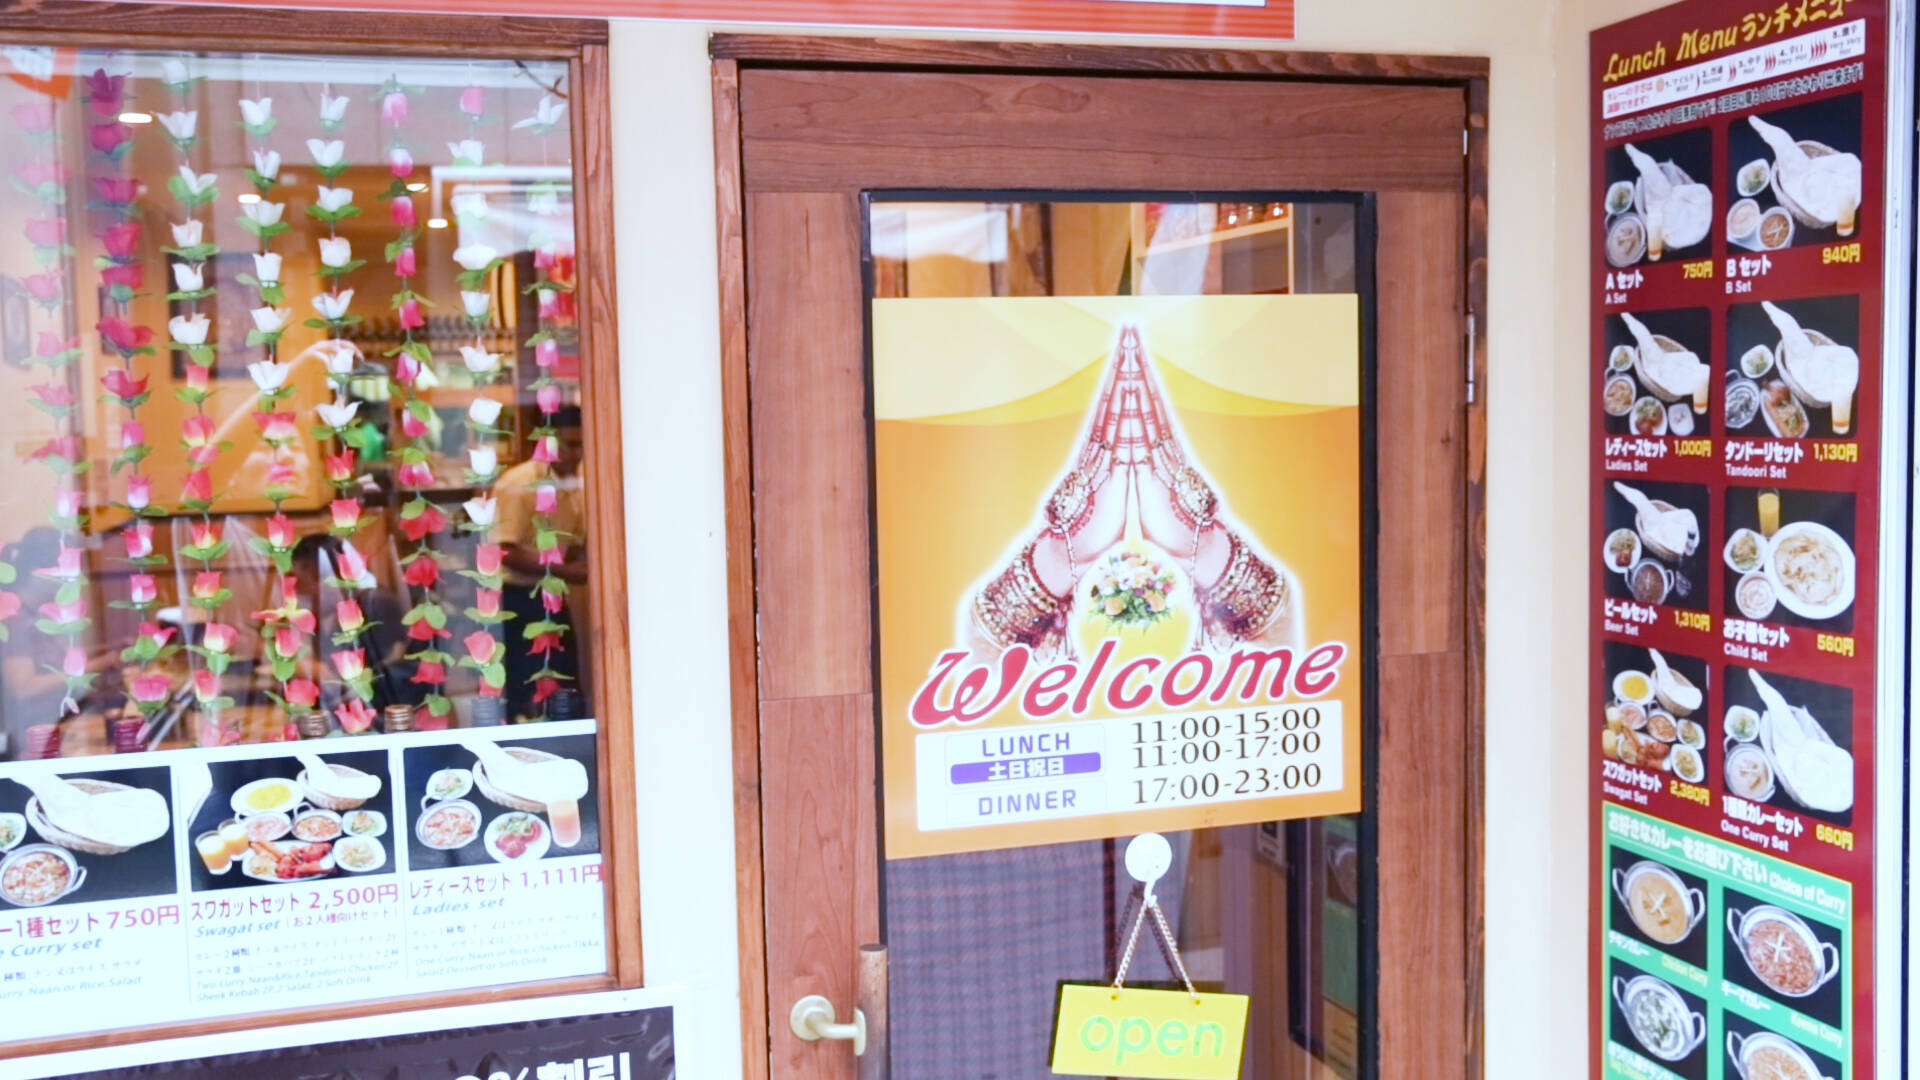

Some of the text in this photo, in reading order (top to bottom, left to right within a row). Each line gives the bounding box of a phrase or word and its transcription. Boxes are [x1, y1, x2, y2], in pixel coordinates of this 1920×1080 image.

[1604, 0, 1851, 82] Lunch Menu ランチメニュ
[1726, 243, 1861, 278] B セット 940円
[1605, 261, 1713, 290] A セット 750円
[1725, 280, 1752, 294] B Set
[1605, 292, 1628, 304] A Set
[1605, 437, 1712, 458] レディースセット 1,000円
[1725, 441, 1858, 463] タンドーリセット 1,130円
[1605, 458, 1648, 472] Ladies Set
[1725, 463, 1787, 479] Tandoori Set
[1604, 599, 1710, 632] ビールセット 1,310円
[1604, 619, 1639, 637] Beer Set
[1723, 642, 1768, 663] Child Set
[1817, 634, 1855, 657] 560円
[911, 640, 1347, 726] Welcome
[1131, 707, 1320, 744] 11:00-15:00
[982, 732, 1070, 757] LUNCH
[1132, 731, 1320, 768] 11:00-17:00
[987, 757, 1064, 781] 土日祝日
[1132, 763, 1321, 804] 17:00-23:00
[979, 789, 1076, 816] DINNER
[1721, 819, 1789, 853] One Curry Set
[410, 863, 603, 899] レディースセット 1,111円
[192, 884, 399, 920] スワガットセット 2,500円
[412, 897, 504, 915] Ladies set
[1815, 887, 1847, 914] Curry
[107, 905, 180, 929] 750円
[194, 921, 252, 937] Swagat
[257, 919, 280, 931] set
[11, 942, 67, 957] Curry
[72, 937, 102, 950] set
[1081, 1015, 1223, 1066] open
